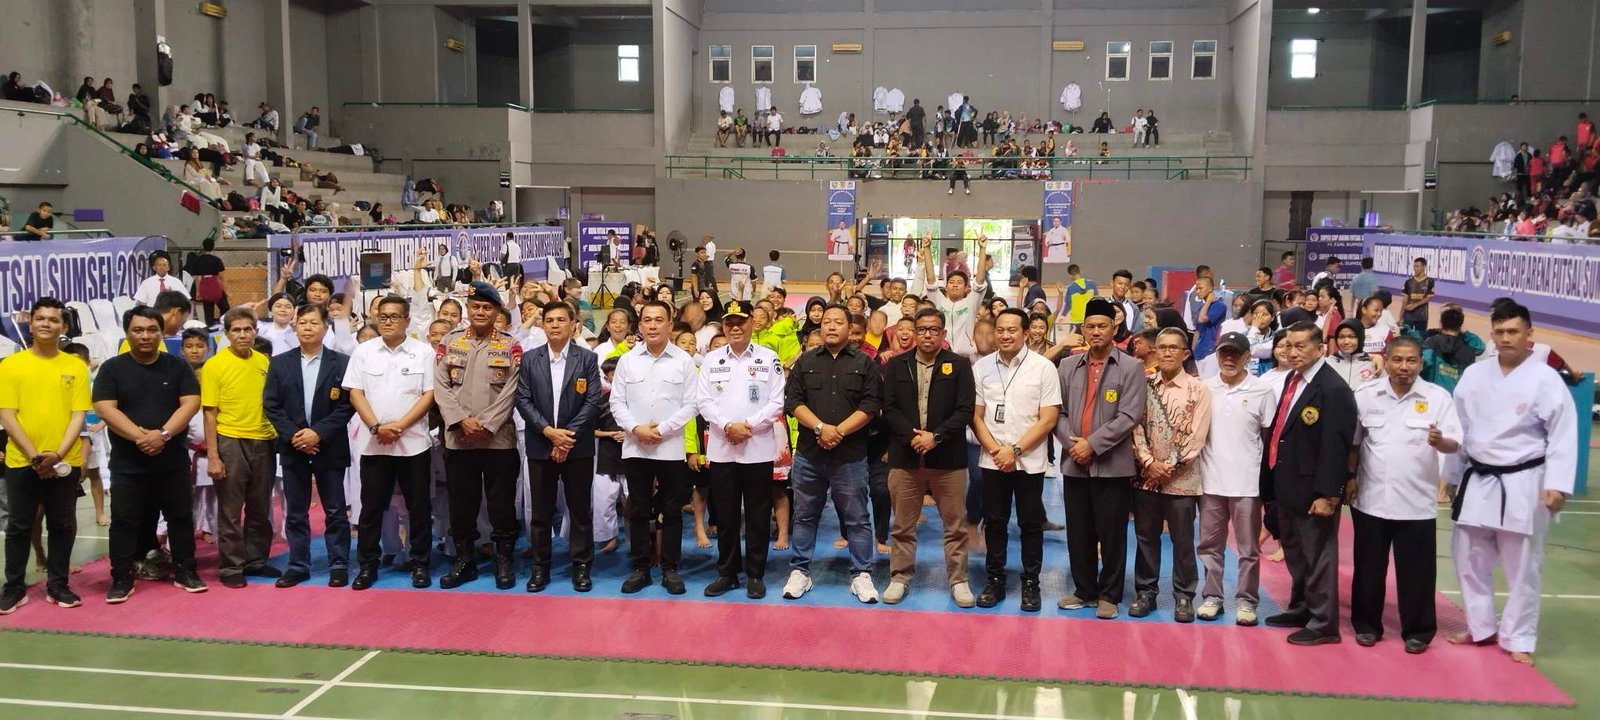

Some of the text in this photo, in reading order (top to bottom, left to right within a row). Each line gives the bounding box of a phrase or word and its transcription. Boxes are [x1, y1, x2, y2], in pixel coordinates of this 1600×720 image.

[48, 253, 115, 304] SUMSEL
[303, 240, 338, 280] ARENA
[1408, 247, 1438, 279] STERA
[1488, 250, 1510, 289] SUPER
[1510, 252, 1526, 292] CUP
[1525, 253, 1554, 297] ARENA
[1553, 255, 1582, 300] FUTSAL
